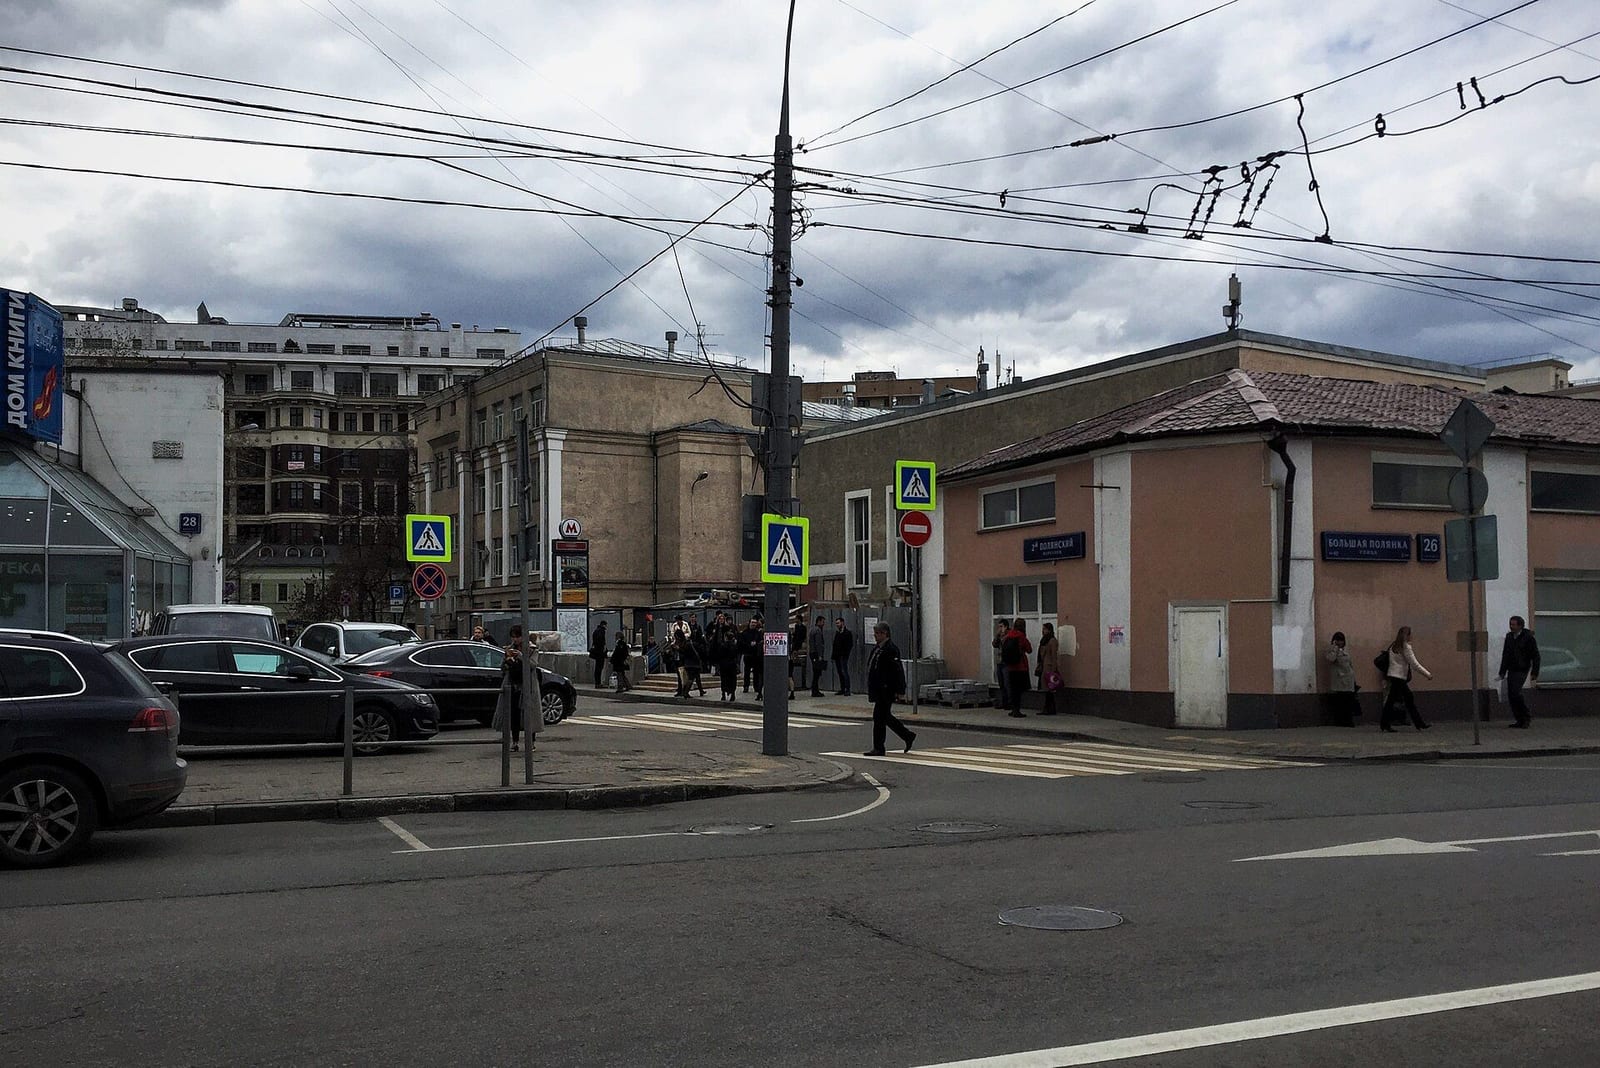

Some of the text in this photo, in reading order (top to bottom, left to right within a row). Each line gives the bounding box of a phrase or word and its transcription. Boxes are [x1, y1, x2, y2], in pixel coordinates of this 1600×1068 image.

[7, 291, 28, 429] ДОМ КНИГИ
[182, 516, 197, 527] 28
[1328, 538, 1409, 550] БОЛЬШАЯ ПОЛЯНКА
[1423, 538, 1438, 552] 26
